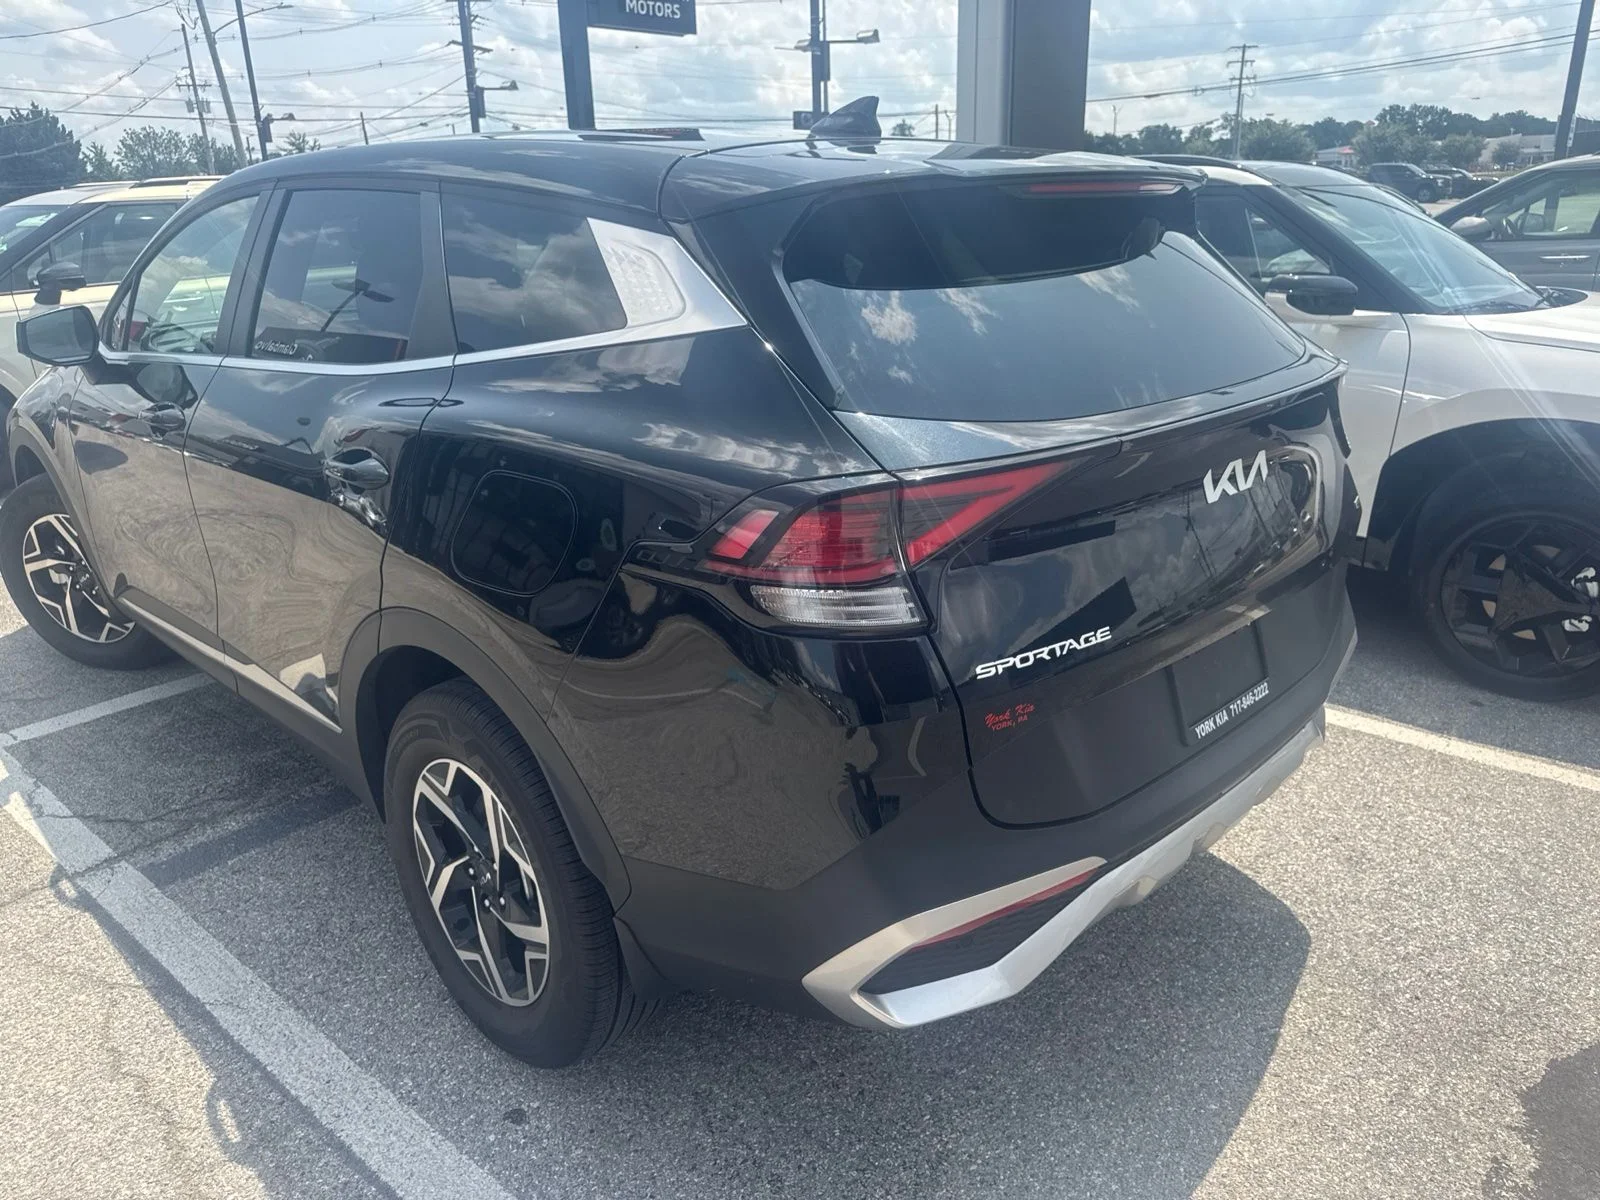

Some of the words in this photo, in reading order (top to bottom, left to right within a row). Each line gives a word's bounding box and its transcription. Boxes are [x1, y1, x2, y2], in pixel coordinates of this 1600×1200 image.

[626, 0, 681, 19] MOTORS
[1203, 449, 1268, 504] KIA
[975, 626, 1112, 680] SPORTAGE
[1195, 717, 1216, 739] YORK
[1215, 709, 1229, 727] KIA
[1229, 682, 1269, 717] 717-846-2222
